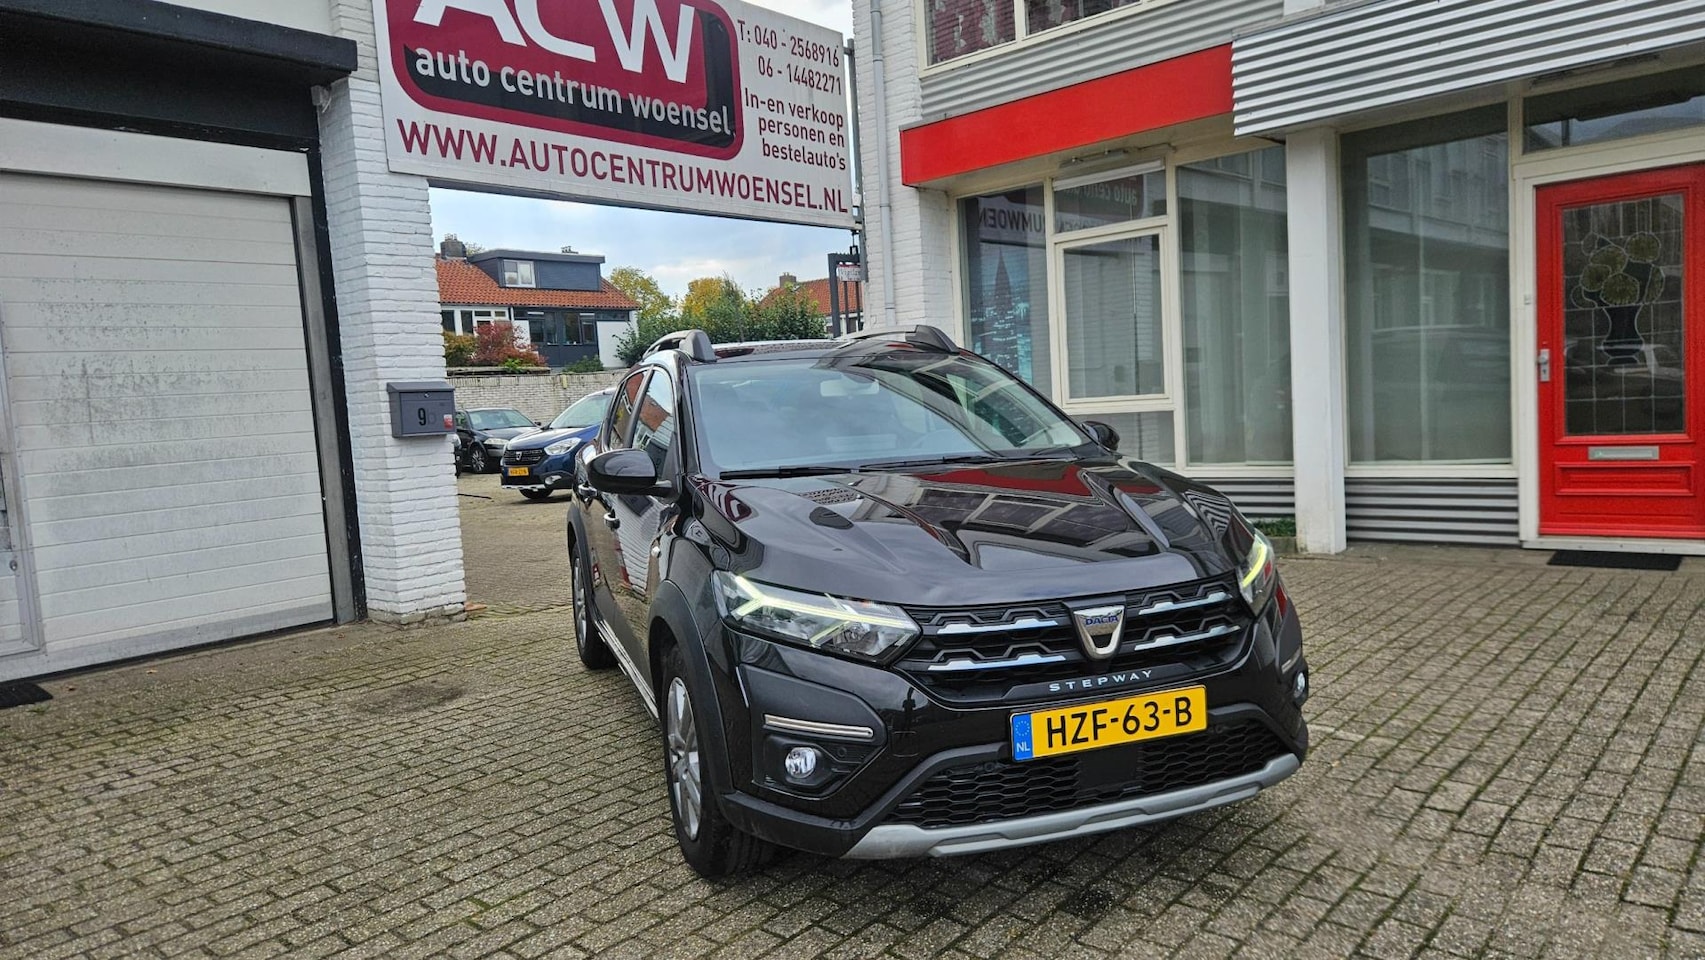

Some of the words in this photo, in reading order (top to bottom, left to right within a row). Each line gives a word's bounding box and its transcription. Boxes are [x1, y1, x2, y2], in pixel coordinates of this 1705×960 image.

[754, 25, 778, 50] 040
[790, 35, 839, 68] 2568916
[415, 48, 490, 87] auto
[500, 66, 623, 114] centrum
[629, 92, 731, 135] woensel
[758, 55, 774, 78] 06
[787, 63, 842, 96] 14482271
[758, 116, 825, 144] personen
[829, 132, 845, 148] en
[788, 102, 844, 132] verkoop
[396, 118, 848, 213] WWW.AUTOCENTRUMWOENSEL.NL
[762, 138, 846, 171] bestelauto's
[1085, 615, 1119, 625] DACIA
[1049, 670, 1152, 692] STEPWAY
[1016, 741, 1031, 752] NL
[1047, 696, 1193, 748] HZF-63-B
